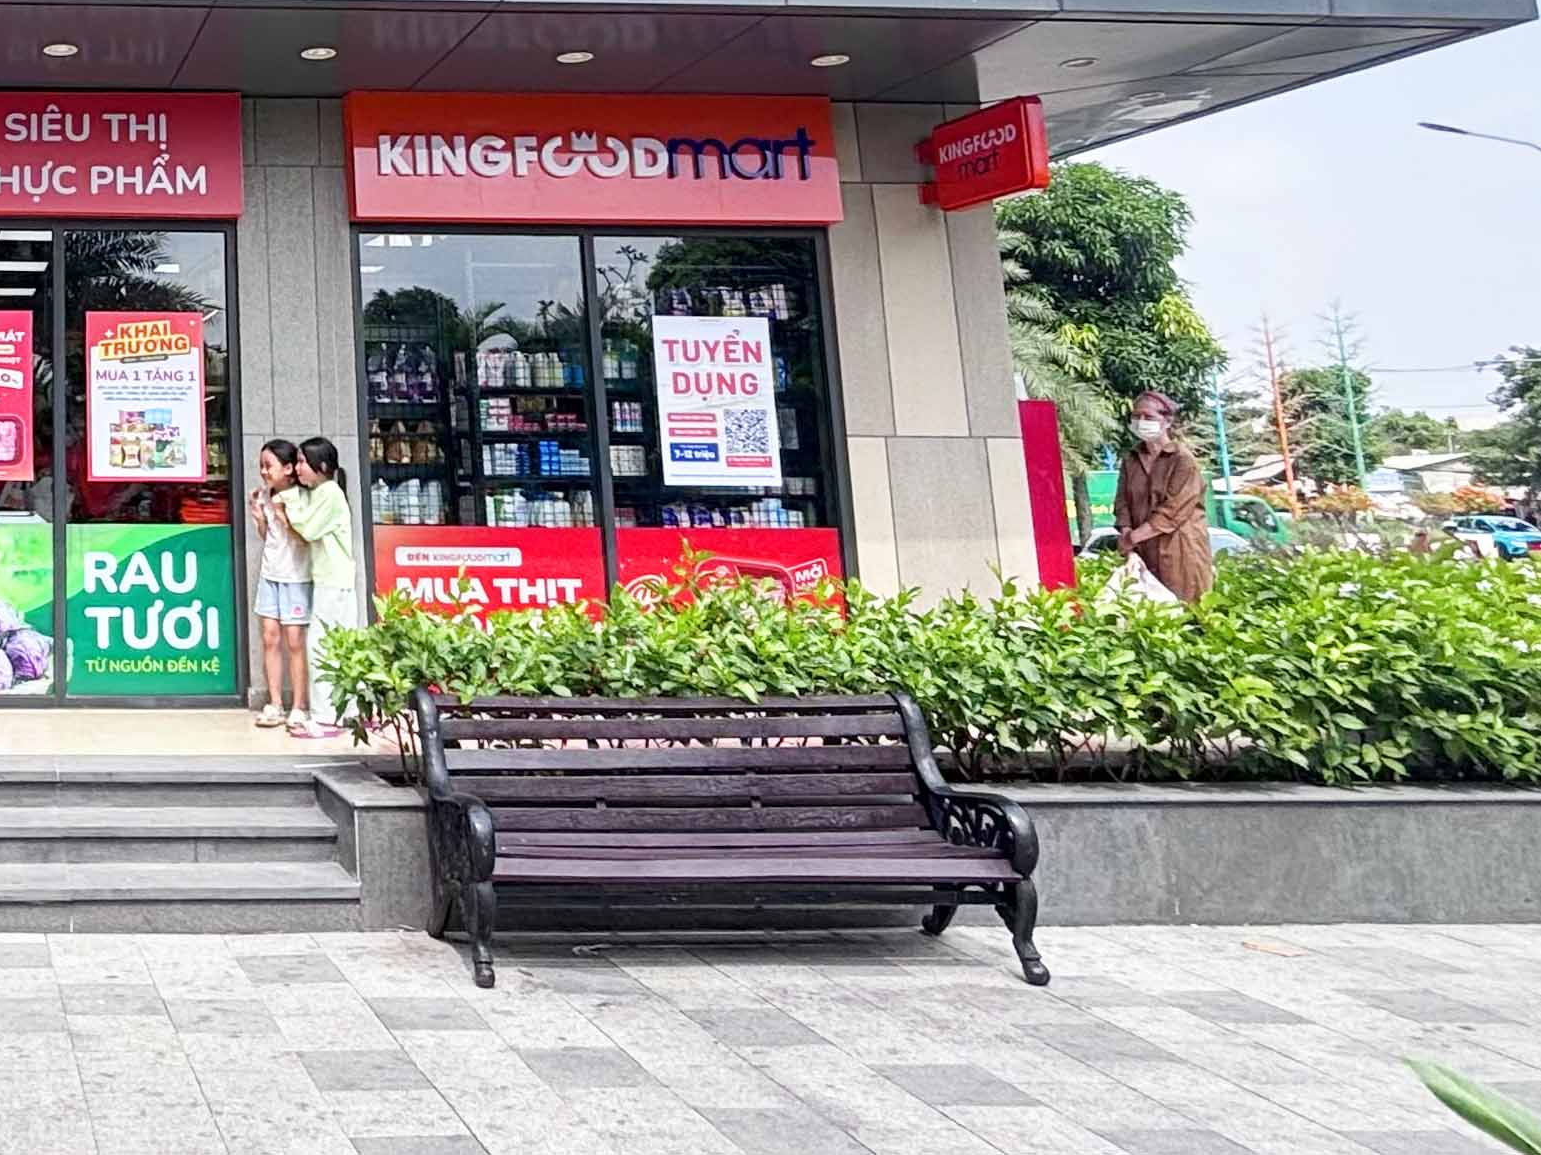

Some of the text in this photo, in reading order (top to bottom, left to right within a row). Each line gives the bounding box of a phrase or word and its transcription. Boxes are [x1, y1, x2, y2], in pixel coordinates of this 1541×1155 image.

[5, 105, 168, 150] SIÊU THỊ
[939, 123, 1016, 165] KINGFOOD
[90, 153, 208, 195] PHẨM
[957, 149, 1000, 180] mart
[119, 323, 168, 339] KHAI
[661, 329, 763, 363] TUYỂN
[96, 369, 129, 381] MUA
[133, 369, 141, 381] 1
[189, 370, 196, 381] 1
[671, 371, 759, 401] DỤNG
[83, 550, 198, 594] RAU
[395, 576, 583, 608] MUA THỊT
[83, 599, 220, 650] TƯƠI
[85, 655, 108, 673] TỪ
[109, 655, 164, 673] NGUỒN
[167, 655, 198, 673] ĐẾN
